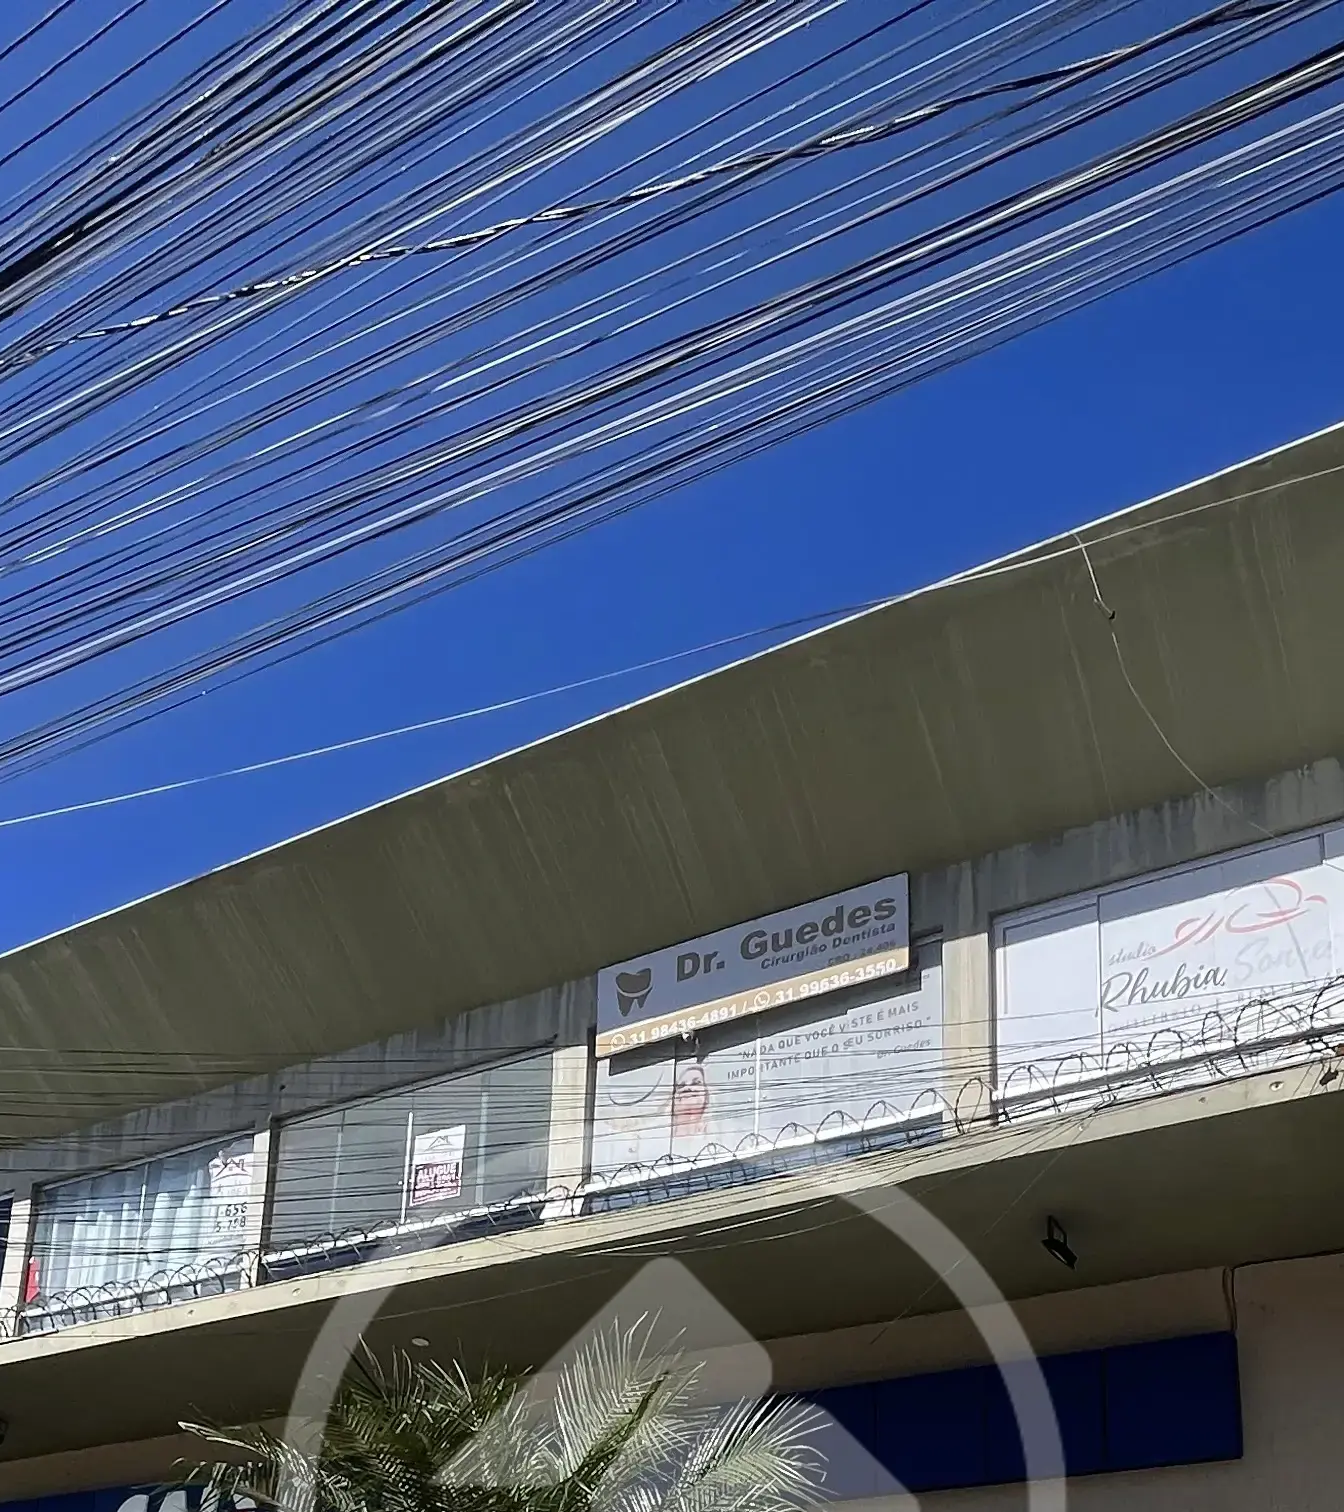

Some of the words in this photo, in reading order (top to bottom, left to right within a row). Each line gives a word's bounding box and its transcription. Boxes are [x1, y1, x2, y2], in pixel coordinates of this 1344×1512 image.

[676, 951, 726, 982] Dr.
[740, 895, 897, 961] Guedes
[760, 941, 828, 970] Cirurgião
[832, 922, 896, 948] Dentista
[1108, 941, 1157, 966] studio
[774, 988, 794, 1006] 31
[778, 1037, 802, 1050] QUE
[804, 1024, 835, 1042] VOCÊ
[876, 1007, 885, 1021] É
[887, 1001, 919, 1019] MAIS
[804, 1046, 828, 1060] QUE
